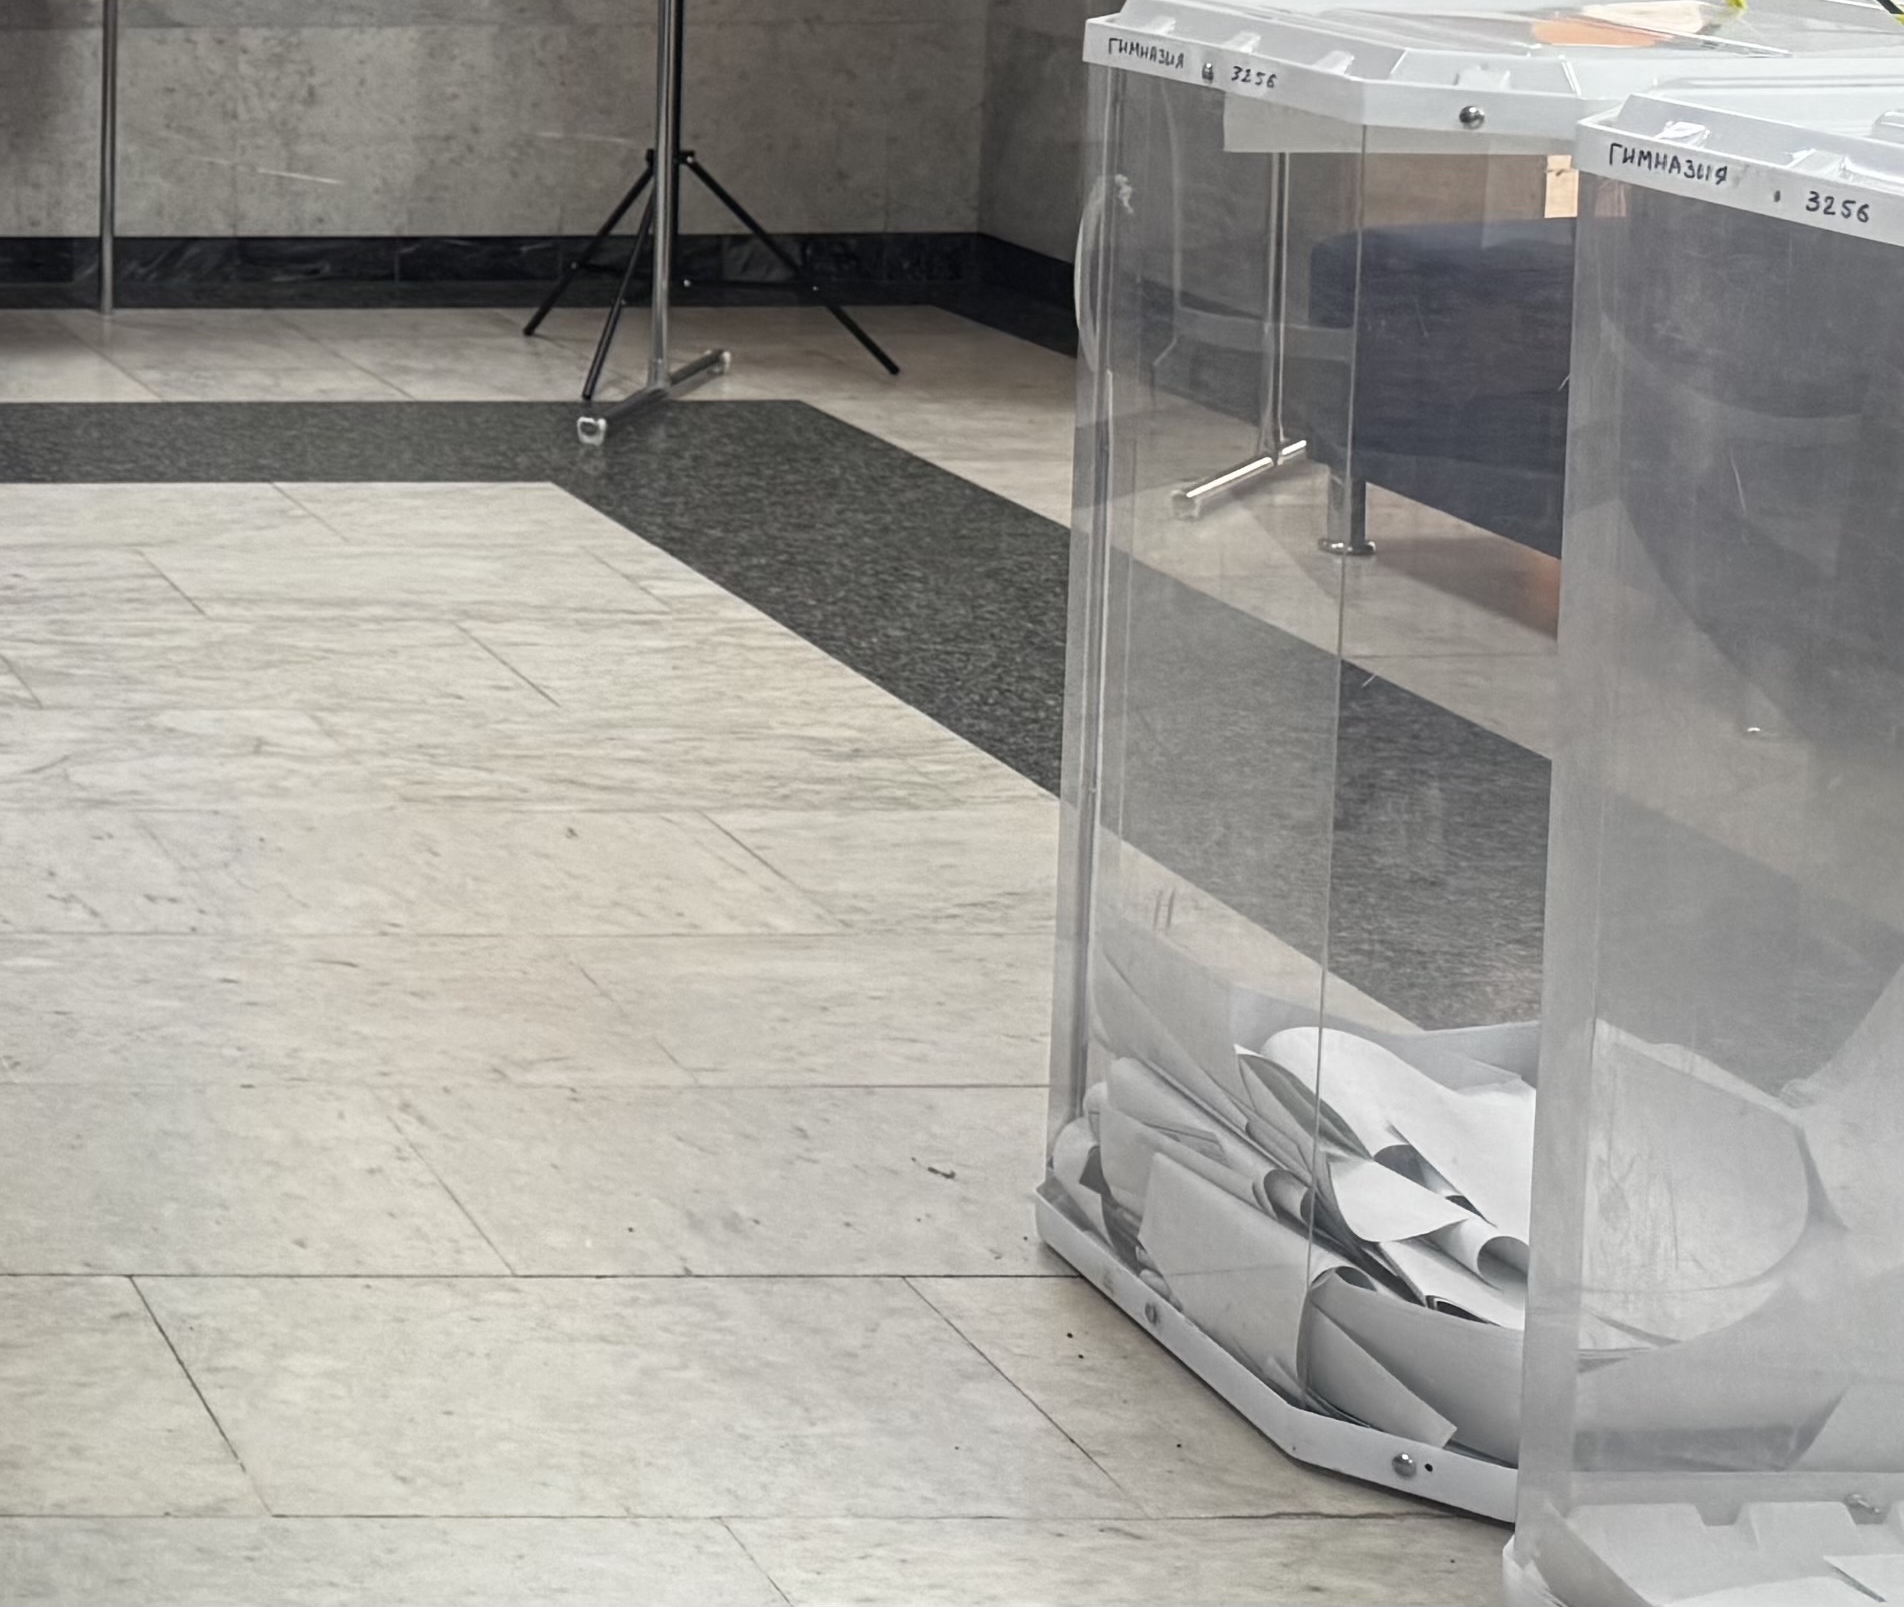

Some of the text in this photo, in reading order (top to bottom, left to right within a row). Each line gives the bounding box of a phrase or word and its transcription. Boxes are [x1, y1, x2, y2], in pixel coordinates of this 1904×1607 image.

[1108, 37, 1278, 88] ГИМНАЗИЯ 3256
[1609, 142, 1870, 223] ГИМНАЗИЯ 3256
